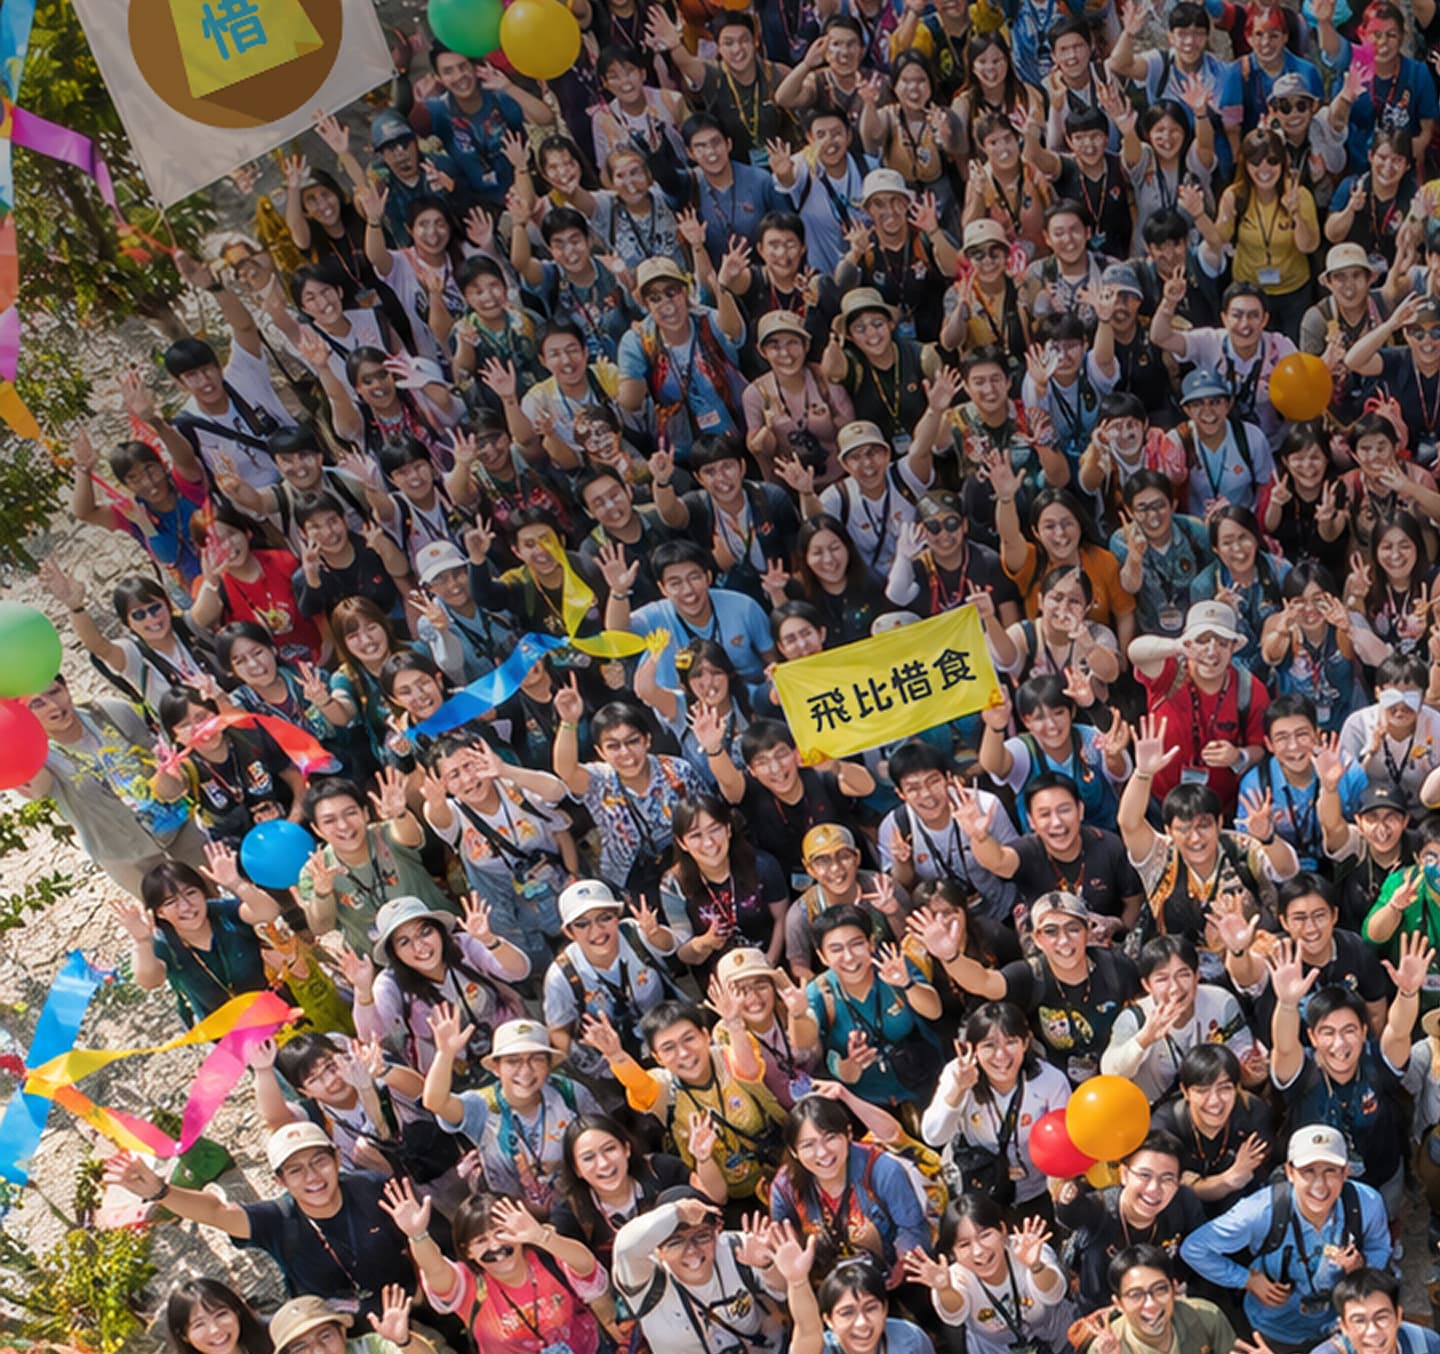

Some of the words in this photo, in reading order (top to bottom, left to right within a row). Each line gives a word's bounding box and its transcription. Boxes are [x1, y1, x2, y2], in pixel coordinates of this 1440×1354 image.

[201, 0, 268, 60] 惜
[806, 648, 977, 733] 飛比惜食
